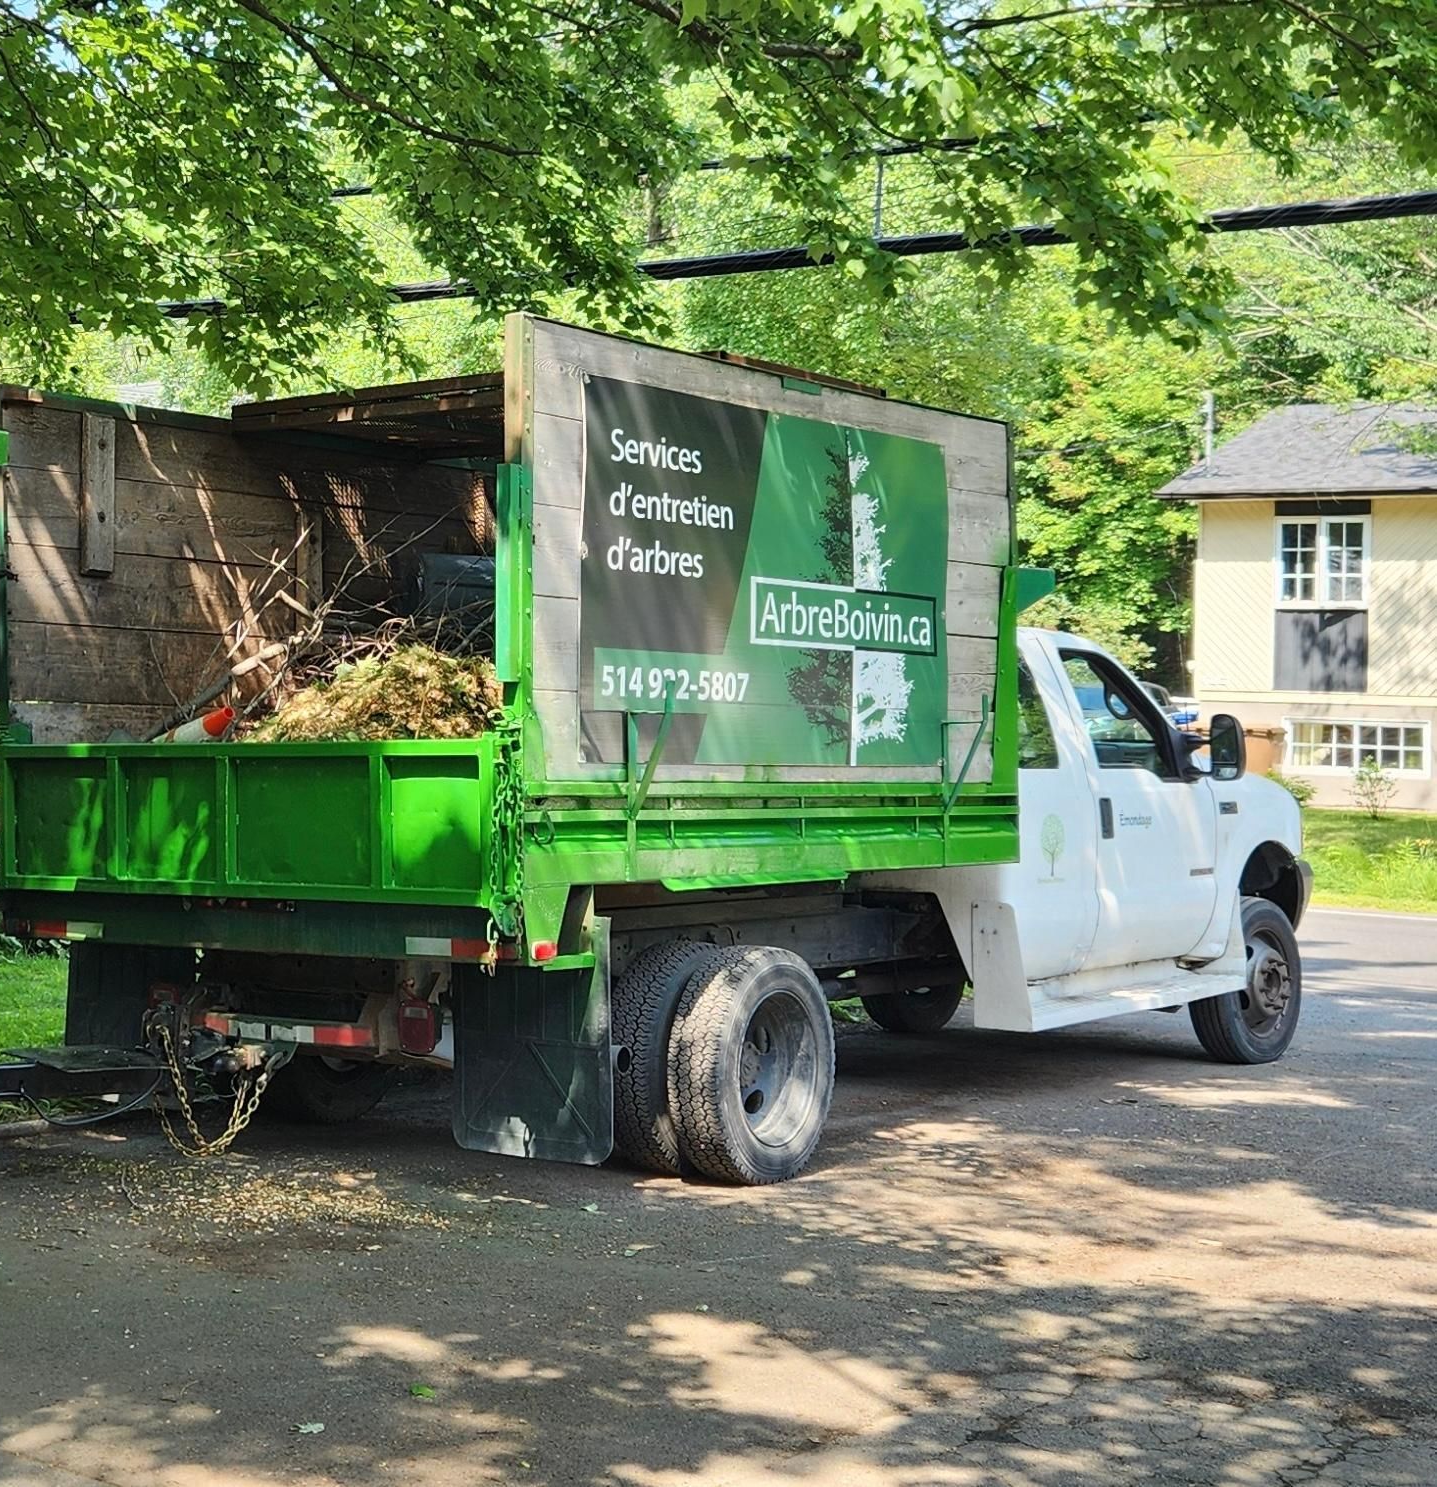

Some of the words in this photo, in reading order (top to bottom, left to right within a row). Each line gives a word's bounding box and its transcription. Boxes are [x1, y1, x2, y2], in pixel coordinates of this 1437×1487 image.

[610, 428, 703, 474] Services
[609, 482, 734, 530] d'entretien
[606, 536, 704, 579] d'arbres
[759, 591, 931, 646] ArbreBoivin.ca
[601, 665, 643, 698] 514
